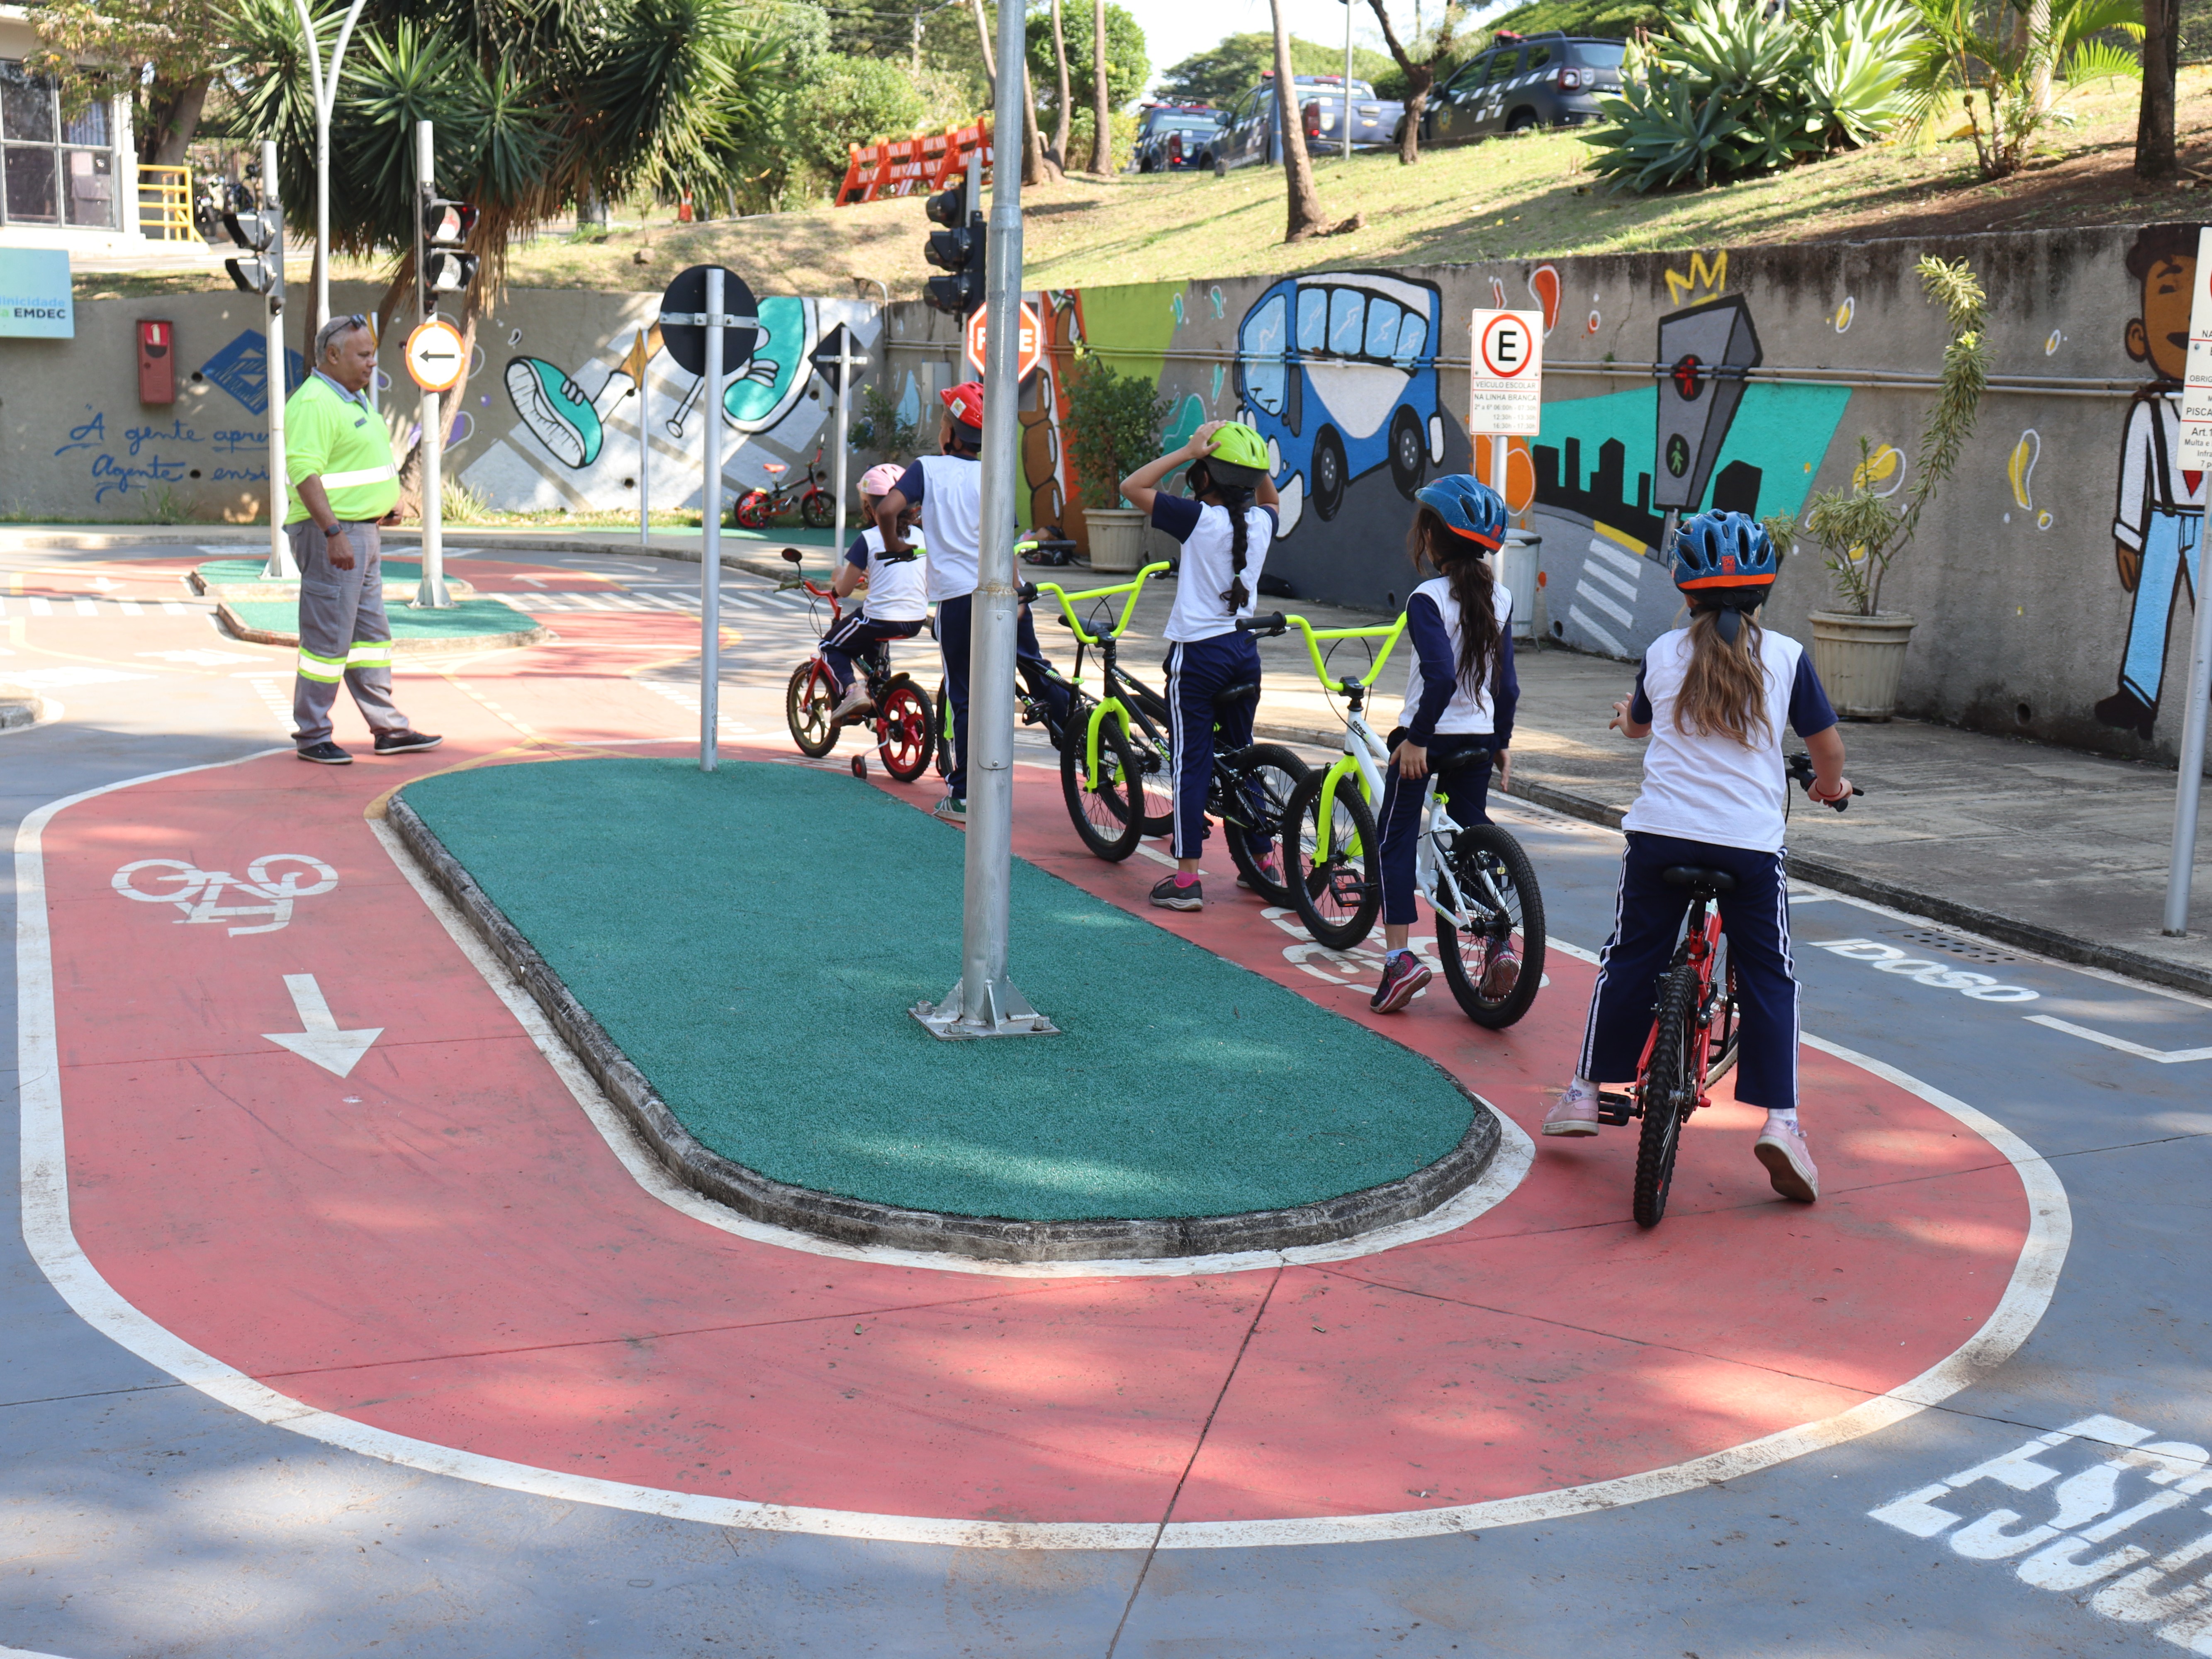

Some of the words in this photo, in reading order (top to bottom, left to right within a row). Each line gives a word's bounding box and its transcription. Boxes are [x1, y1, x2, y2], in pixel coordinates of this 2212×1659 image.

[0, 296, 65, 307] inicidade
[14, 308, 66, 319] EMDEC
[977, 327, 1033, 352] PE
[1499, 331, 1516, 361] E
[124, 419, 205, 455] gente
[213, 430, 269, 453] apre
[92, 454, 185, 494] Agente
[211, 465, 270, 481] ensi
[1806, 939, 2040, 1002] IDOSO
[1867, 1414, 2212, 1659] ESC
